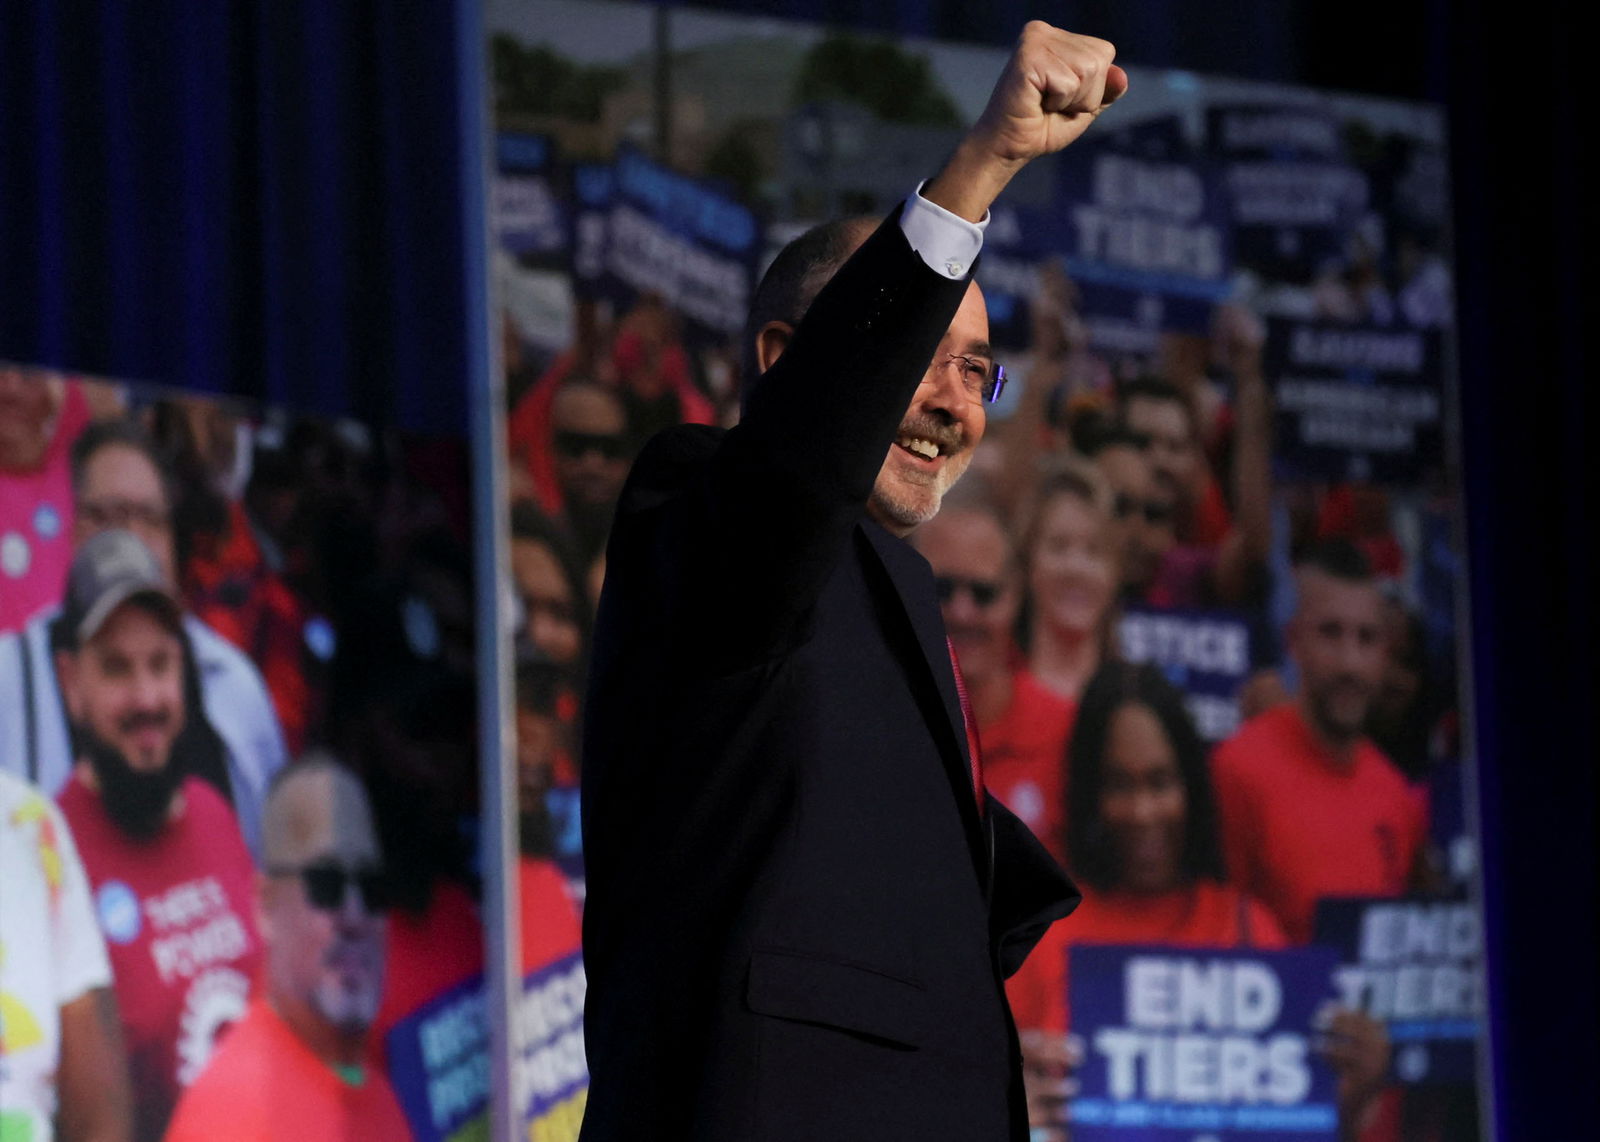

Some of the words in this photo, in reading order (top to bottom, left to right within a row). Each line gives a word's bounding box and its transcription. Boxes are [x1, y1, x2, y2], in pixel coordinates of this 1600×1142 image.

[1093, 154, 1205, 222] END
[1072, 204, 1224, 279] TIERS
[1357, 903, 1480, 961] END
[1123, 956, 1281, 1034] END
[1330, 962, 1480, 1019] TIER
[1095, 1028, 1312, 1105] TIERS
